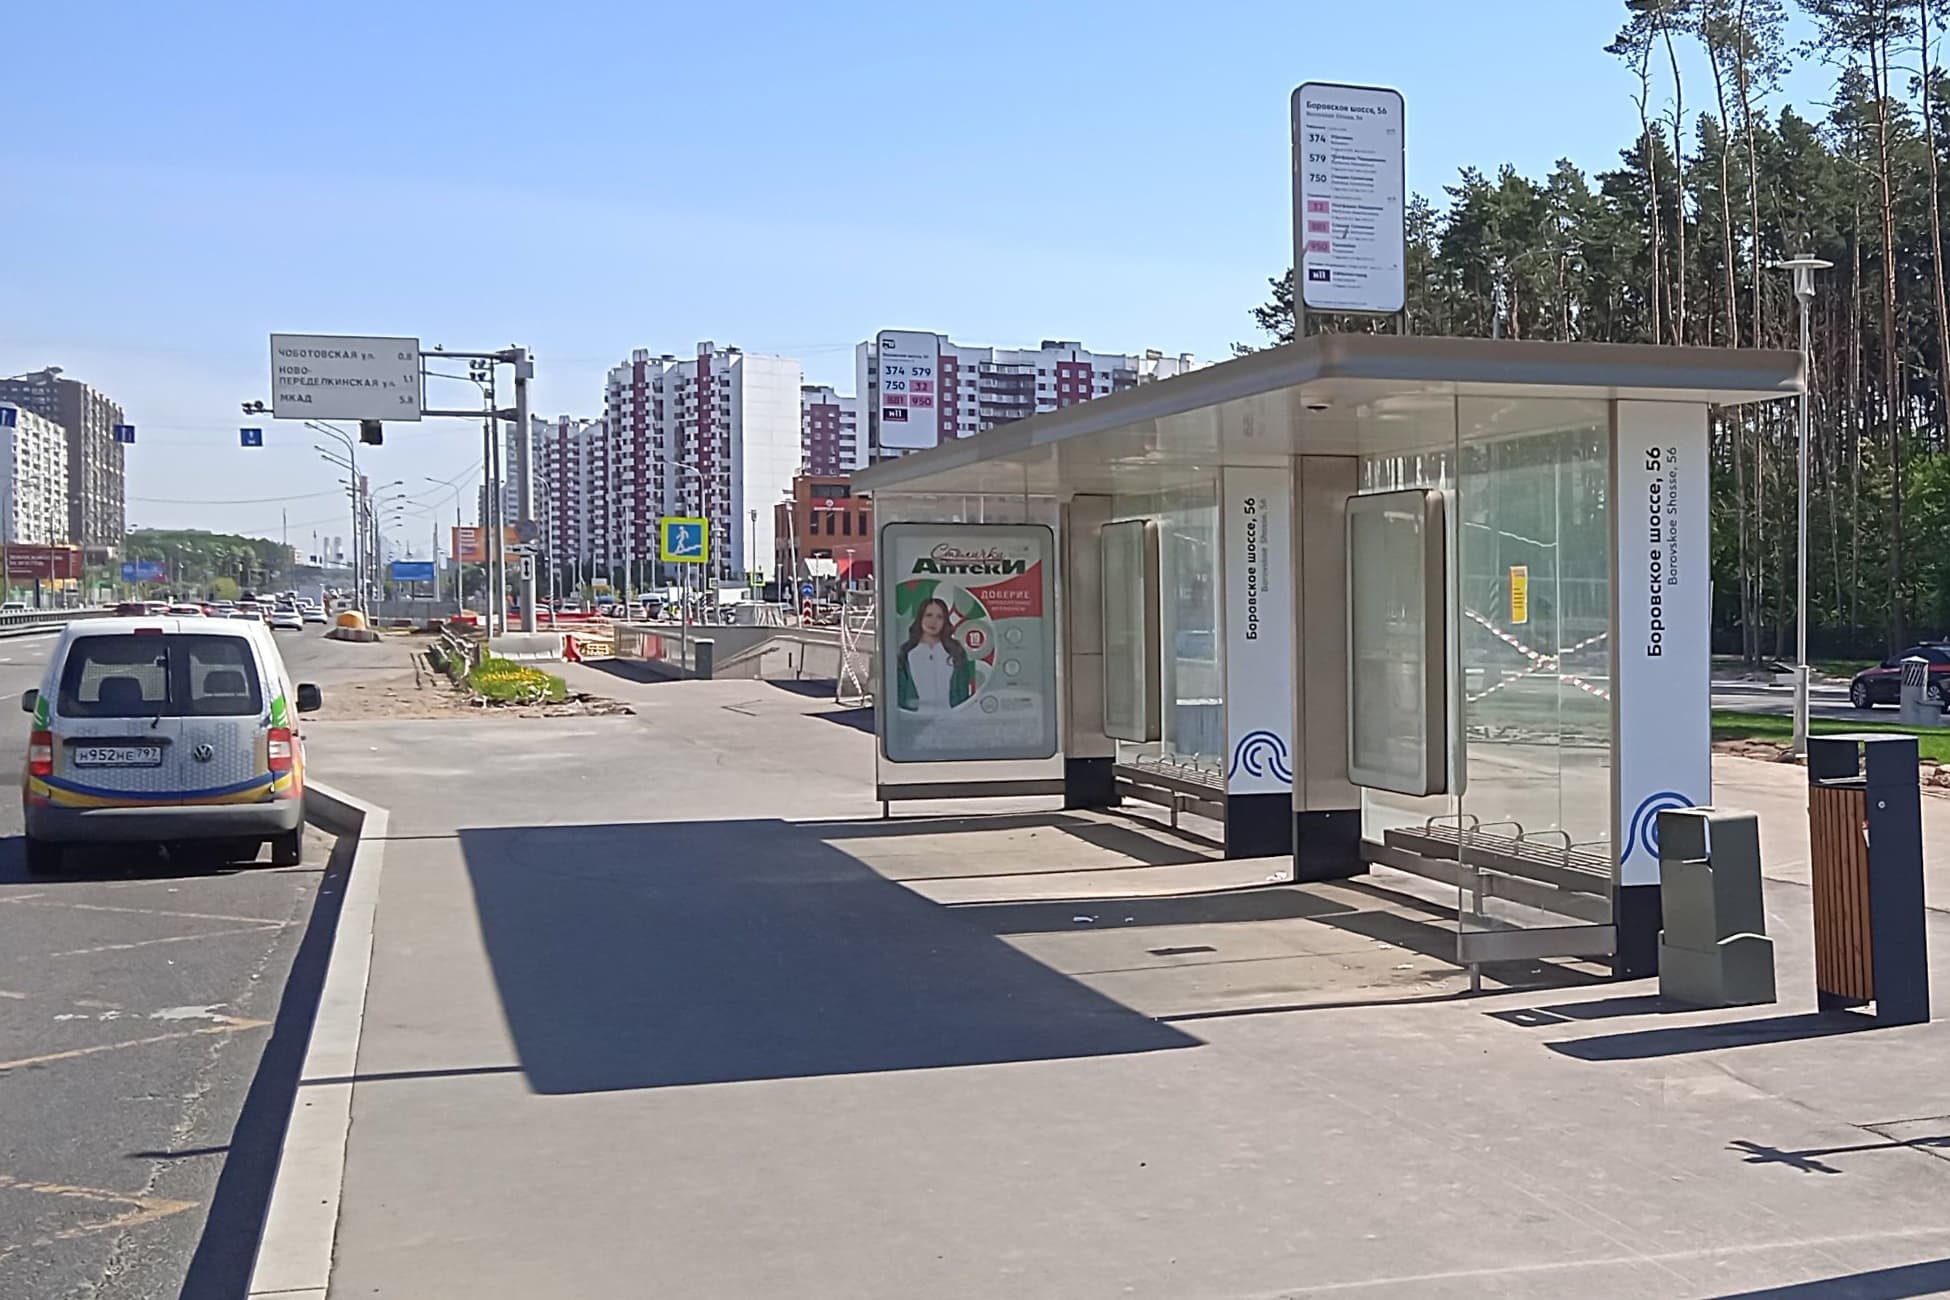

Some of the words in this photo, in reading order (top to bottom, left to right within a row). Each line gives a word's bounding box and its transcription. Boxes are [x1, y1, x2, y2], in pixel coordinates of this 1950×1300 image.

[1306, 101, 1349, 112] Боровское
[1377, 107, 1388, 115] 56
[1309, 134, 1326, 143] 374
[1309, 153, 1327, 162] 579
[1309, 173, 1327, 183] 750
[279, 349, 358, 359] ЧОБОТОВСКАЯ
[279, 366, 312, 375] НОВО-
[885, 366, 905, 375] 374
[912, 367, 931, 377] 579
[279, 377, 379, 387] ПЕРЕДЕЛКИНСКАЯ
[886, 381, 905, 390] 750
[280, 394, 312, 403] МКАД
[1646, 447, 1661, 472] 56
[1667, 447, 1678, 463] 56
[1667, 468, 1678, 514] Shosse,
[1244, 497, 1256, 515] 56
[1650, 478, 1664, 543] шоссе,
[1247, 518, 1257, 563] шоссе,
[1667, 519, 1678, 586] Borovskoe
[1246, 567, 1259, 640] Боровское
[1646, 549, 1665, 657] Боровское
